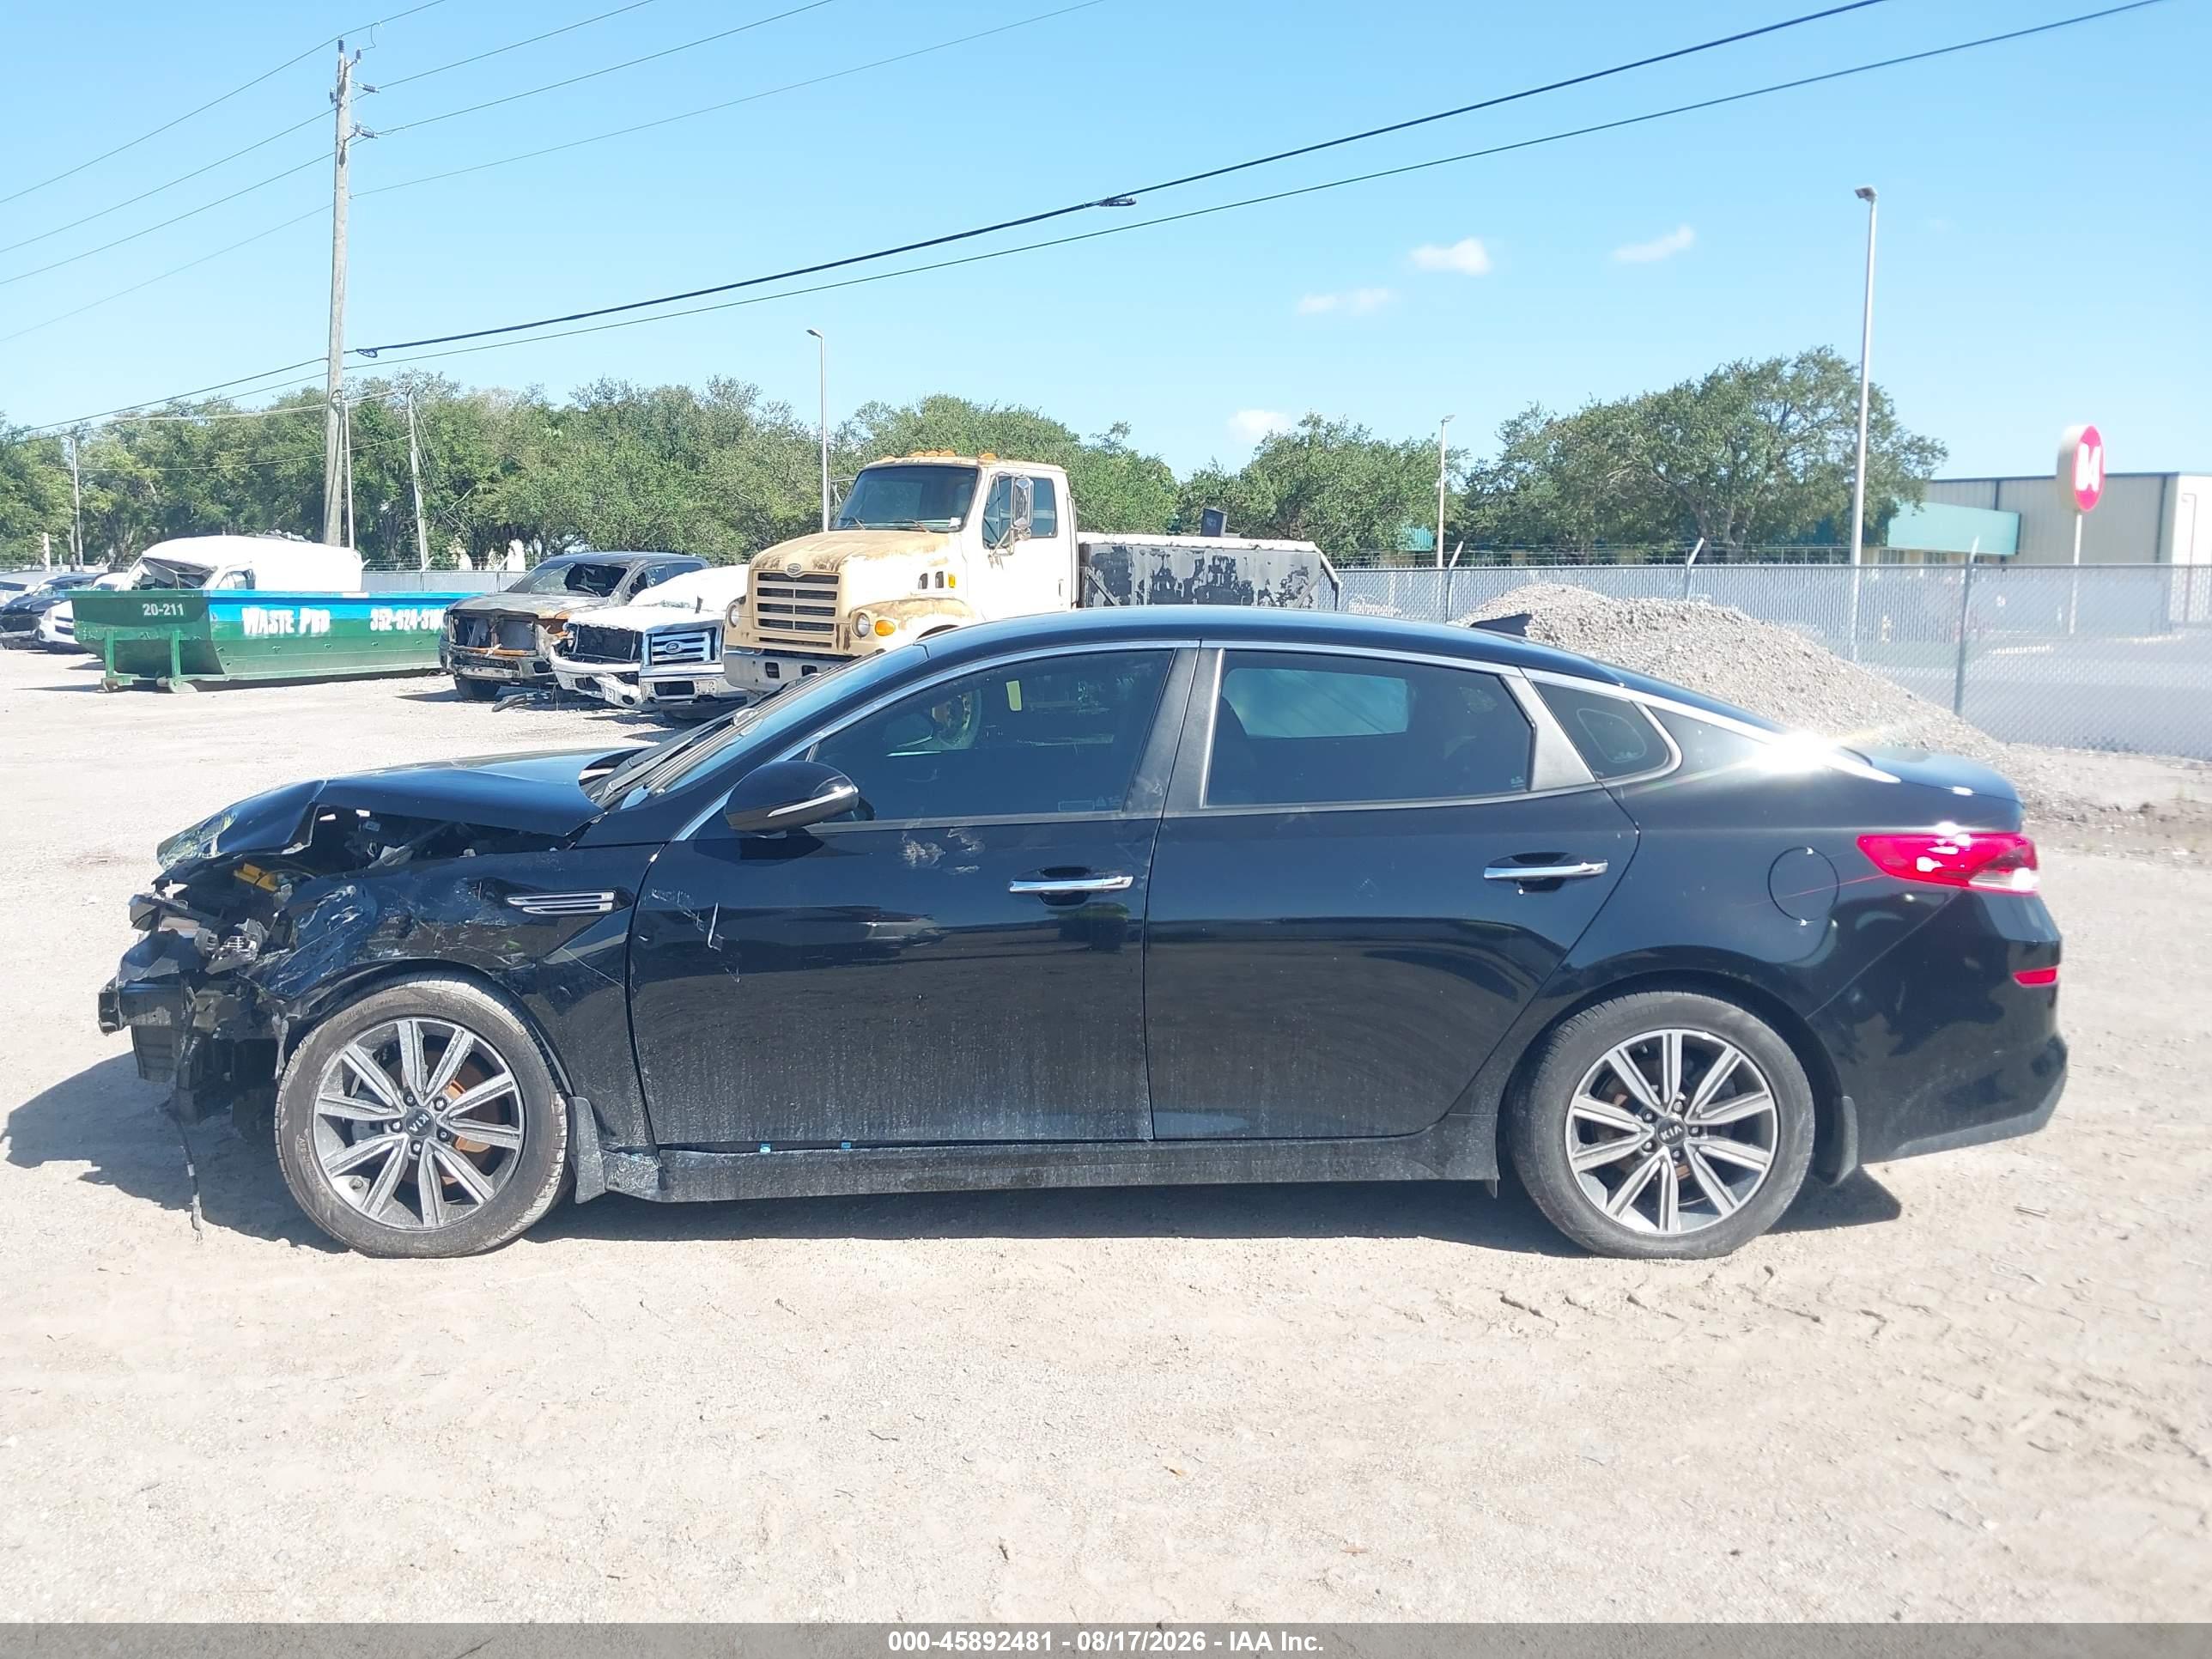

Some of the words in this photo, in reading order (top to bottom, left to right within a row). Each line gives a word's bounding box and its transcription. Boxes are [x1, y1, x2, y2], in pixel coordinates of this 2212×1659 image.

[142, 603, 185, 617] 20-211
[241, 607, 295, 635] WASTE
[299, 608, 331, 635] PRO
[408, 1113, 430, 1133] KIA
[1659, 1125, 1683, 1140] KIA
